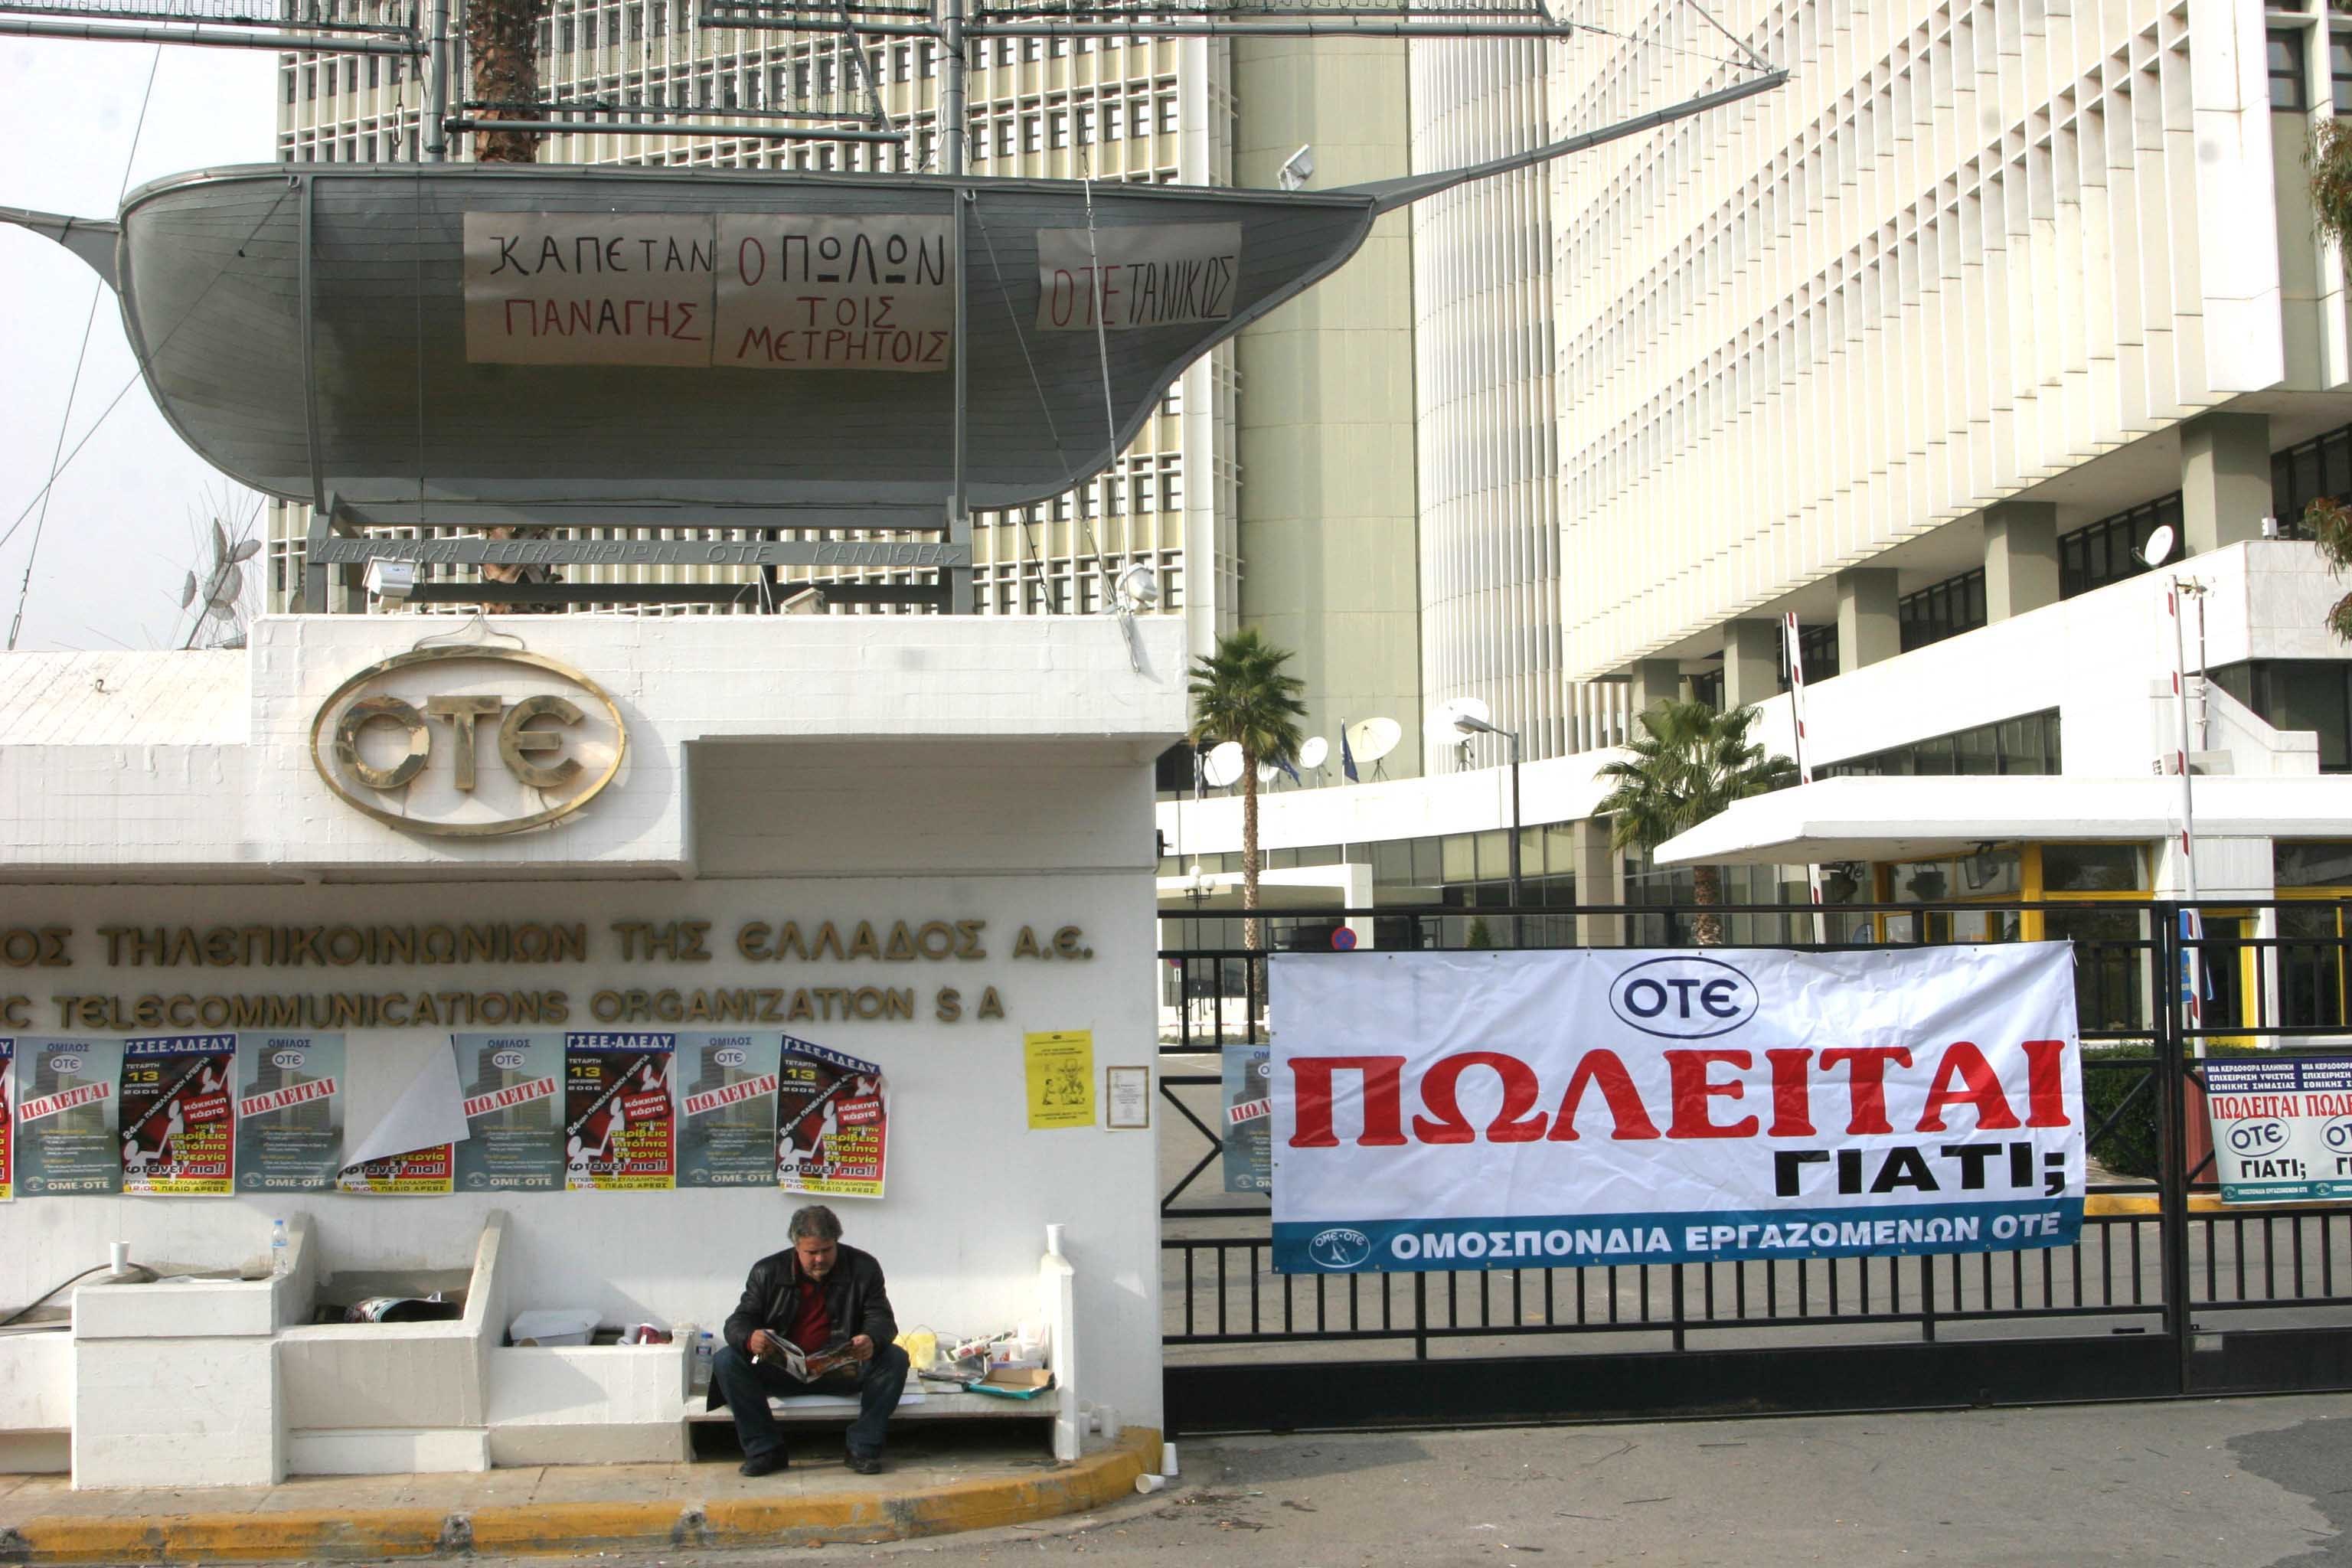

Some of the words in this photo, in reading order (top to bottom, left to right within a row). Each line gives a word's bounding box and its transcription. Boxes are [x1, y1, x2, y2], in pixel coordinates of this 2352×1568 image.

[490, 236, 713, 276] ΚΑΠΕΤΑΝ
[505, 299, 702, 341] ΠΑΝΑΓΗΣ
[796, 296, 897, 330] ΤΟΙΣ
[737, 325, 949, 363] ΜΕΤΡΗΤΟΙΣ
[335, 694, 586, 790] ΟΤΕ
[96, 923, 586, 967] ΤΗΛΕΠΙΚΟΙΝΩΝΙΩΝ
[610, 920, 712, 962] ΤΗΣ
[737, 920, 986, 962] ΕΛΛΑΔΟΣ
[52, 990, 570, 1030] TELECOMMUNICATIONS
[590, 986, 913, 1023] ORGANIZATION
[1623, 978, 1741, 1020] ΟΤΕ
[47, 1042, 91, 1052] ΟΜΙΛΟΣ
[268, 1039, 312, 1048] ΟΜΙΛΟΣ
[488, 1039, 531, 1048] ΟΜΙΛΟΣ
[710, 1037, 753, 1046] ΟΜΙΛΟΣ
[717, 1053, 743, 1063] ΟΤΕ
[53, 1059, 79, 1069] ΟΤΕ
[128, 1071, 159, 1082] 13
[275, 1055, 301, 1065] ΟΤΕ
[495, 1055, 521, 1065] ΟΤΕ
[571, 1067, 601, 1076] 13
[786, 1068, 815, 1080] 13
[20, 1082, 110, 1120] ΠΩΛΕΙΤΑΙ
[241, 1078, 335, 1116] ΠΩΛΕΙΤΑΙ
[464, 1077, 556, 1116] ΠΩΛΕΙΤΑΙ
[686, 1074, 777, 1114] ΠΩΛΕΙΤΑΙ
[1288, 1039, 2072, 1148] ΠΩΛΕΙΤΑΙ
[2211, 1096, 2300, 1119] ΠΩΛΕΙΤΑΙ
[2231, 1123, 2283, 1149] ΟΤΕ
[1774, 1142, 2066, 1197] ΓΙΑΤΙ;
[2240, 1158, 2307, 1180] ΓΙΑΤΙ;
[1390, 1227, 1672, 1259] ΟΜΟΣΠΟΝΔΙΑ
[1684, 1217, 1979, 1252] ΕΡΓΑΖΟΜΕΝΩΝ
[1991, 1212, 2061, 1240] ΟΤΕ
